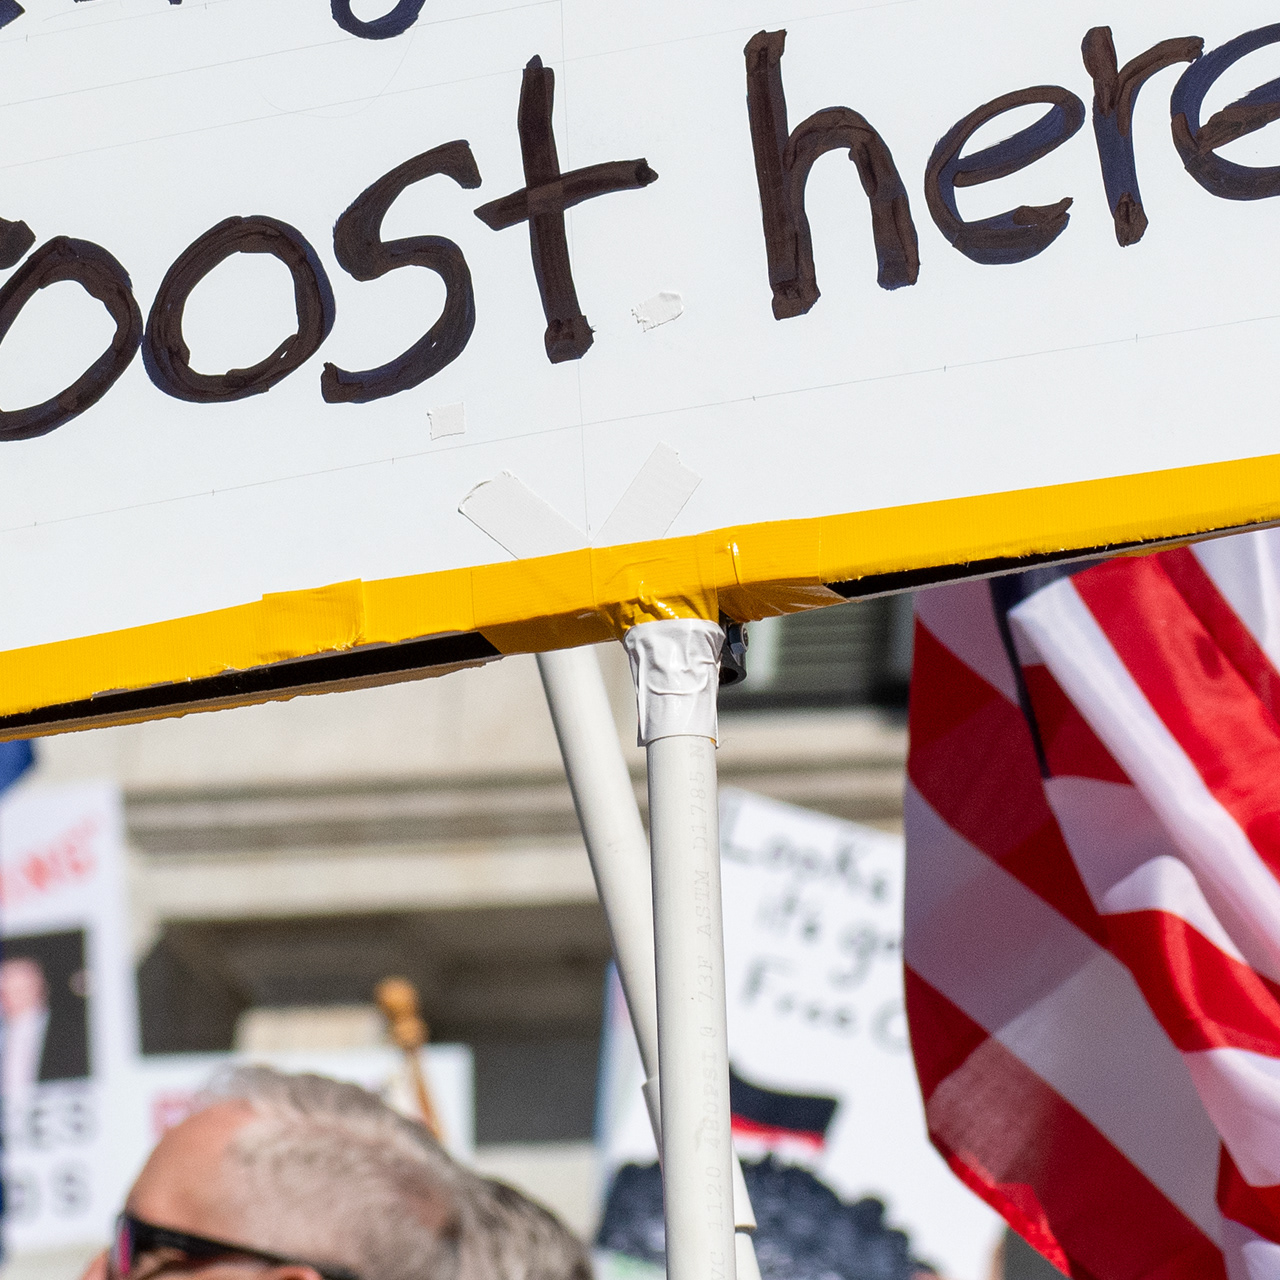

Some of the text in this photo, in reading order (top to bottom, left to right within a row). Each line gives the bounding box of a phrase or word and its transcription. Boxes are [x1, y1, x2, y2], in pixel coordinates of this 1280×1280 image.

[688, 742, 706, 760] N
[688, 770, 708, 852] D1785
[692, 868, 713, 940] ASTM
